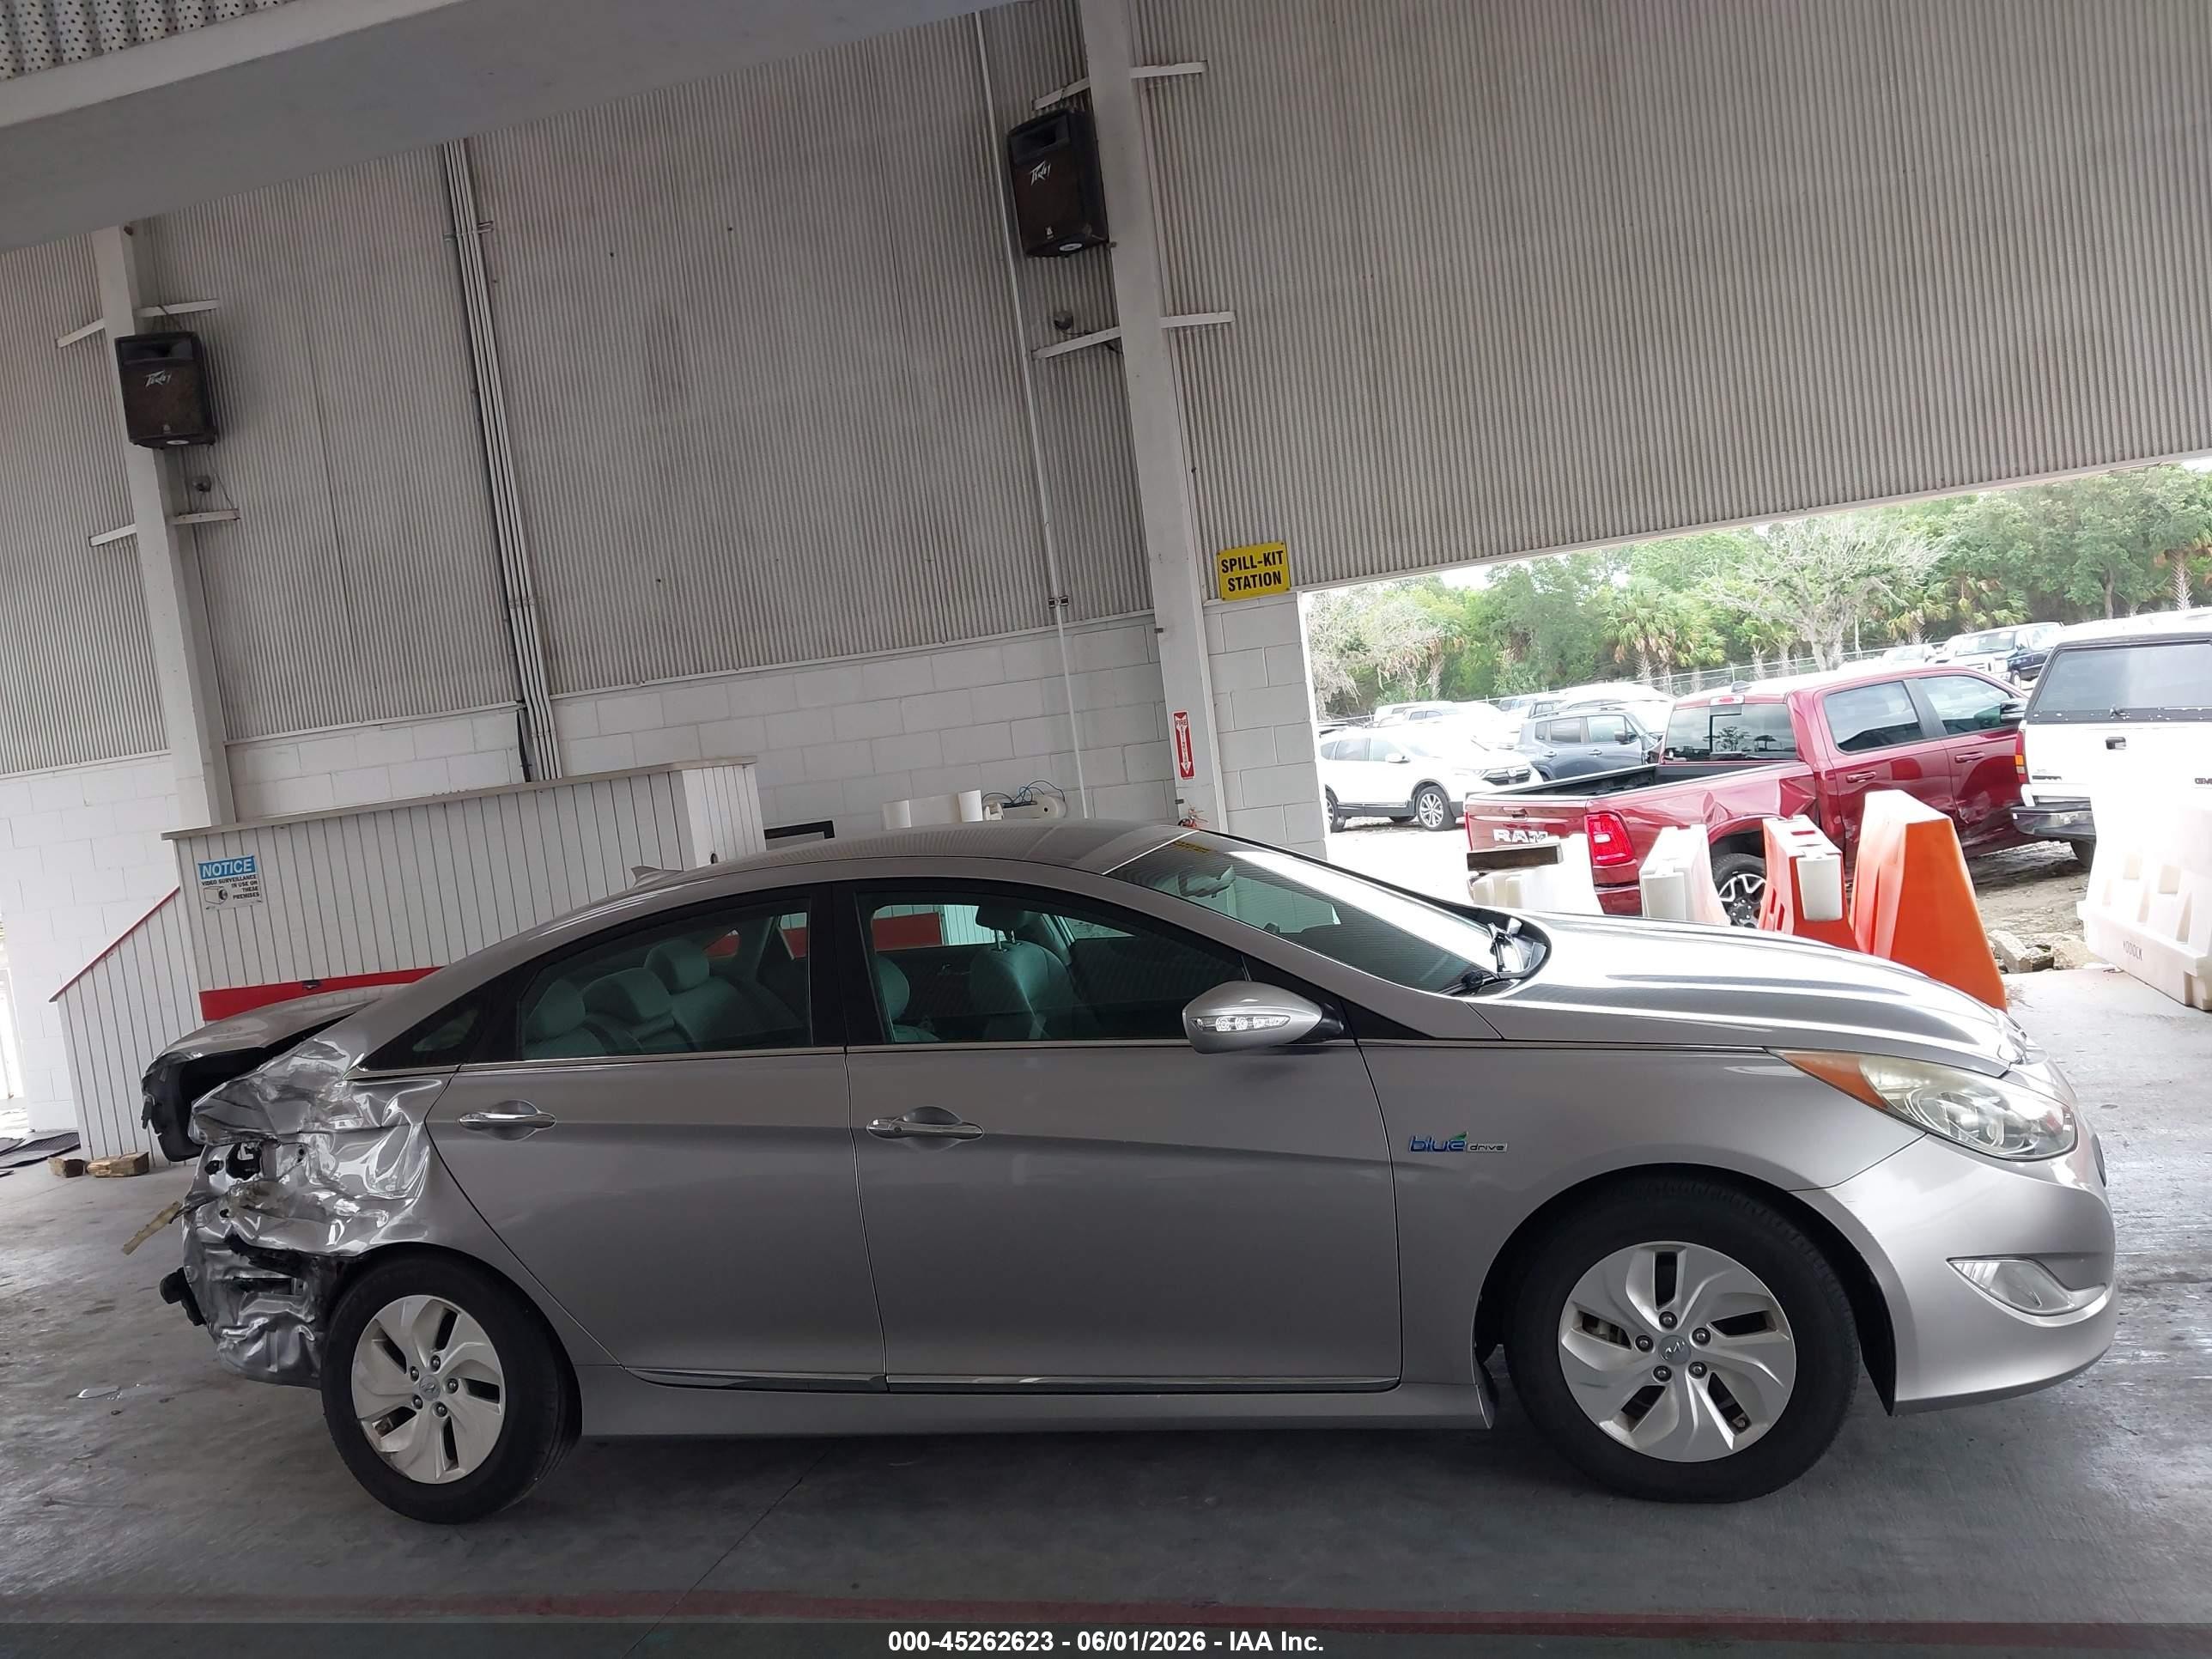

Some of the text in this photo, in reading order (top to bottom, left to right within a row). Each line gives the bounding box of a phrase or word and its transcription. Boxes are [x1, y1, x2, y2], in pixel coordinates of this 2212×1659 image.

[1221, 550, 1284, 574] SPILL-KIT
[1228, 570, 1281, 592] STATION
[1492, 829, 1549, 843] RAM
[202, 858, 252, 878] NOTICE
[218, 874, 258, 884] SURVEILLANCE
[233, 891, 260, 900] PREMISES
[1409, 1134, 1506, 1152] blue drive
